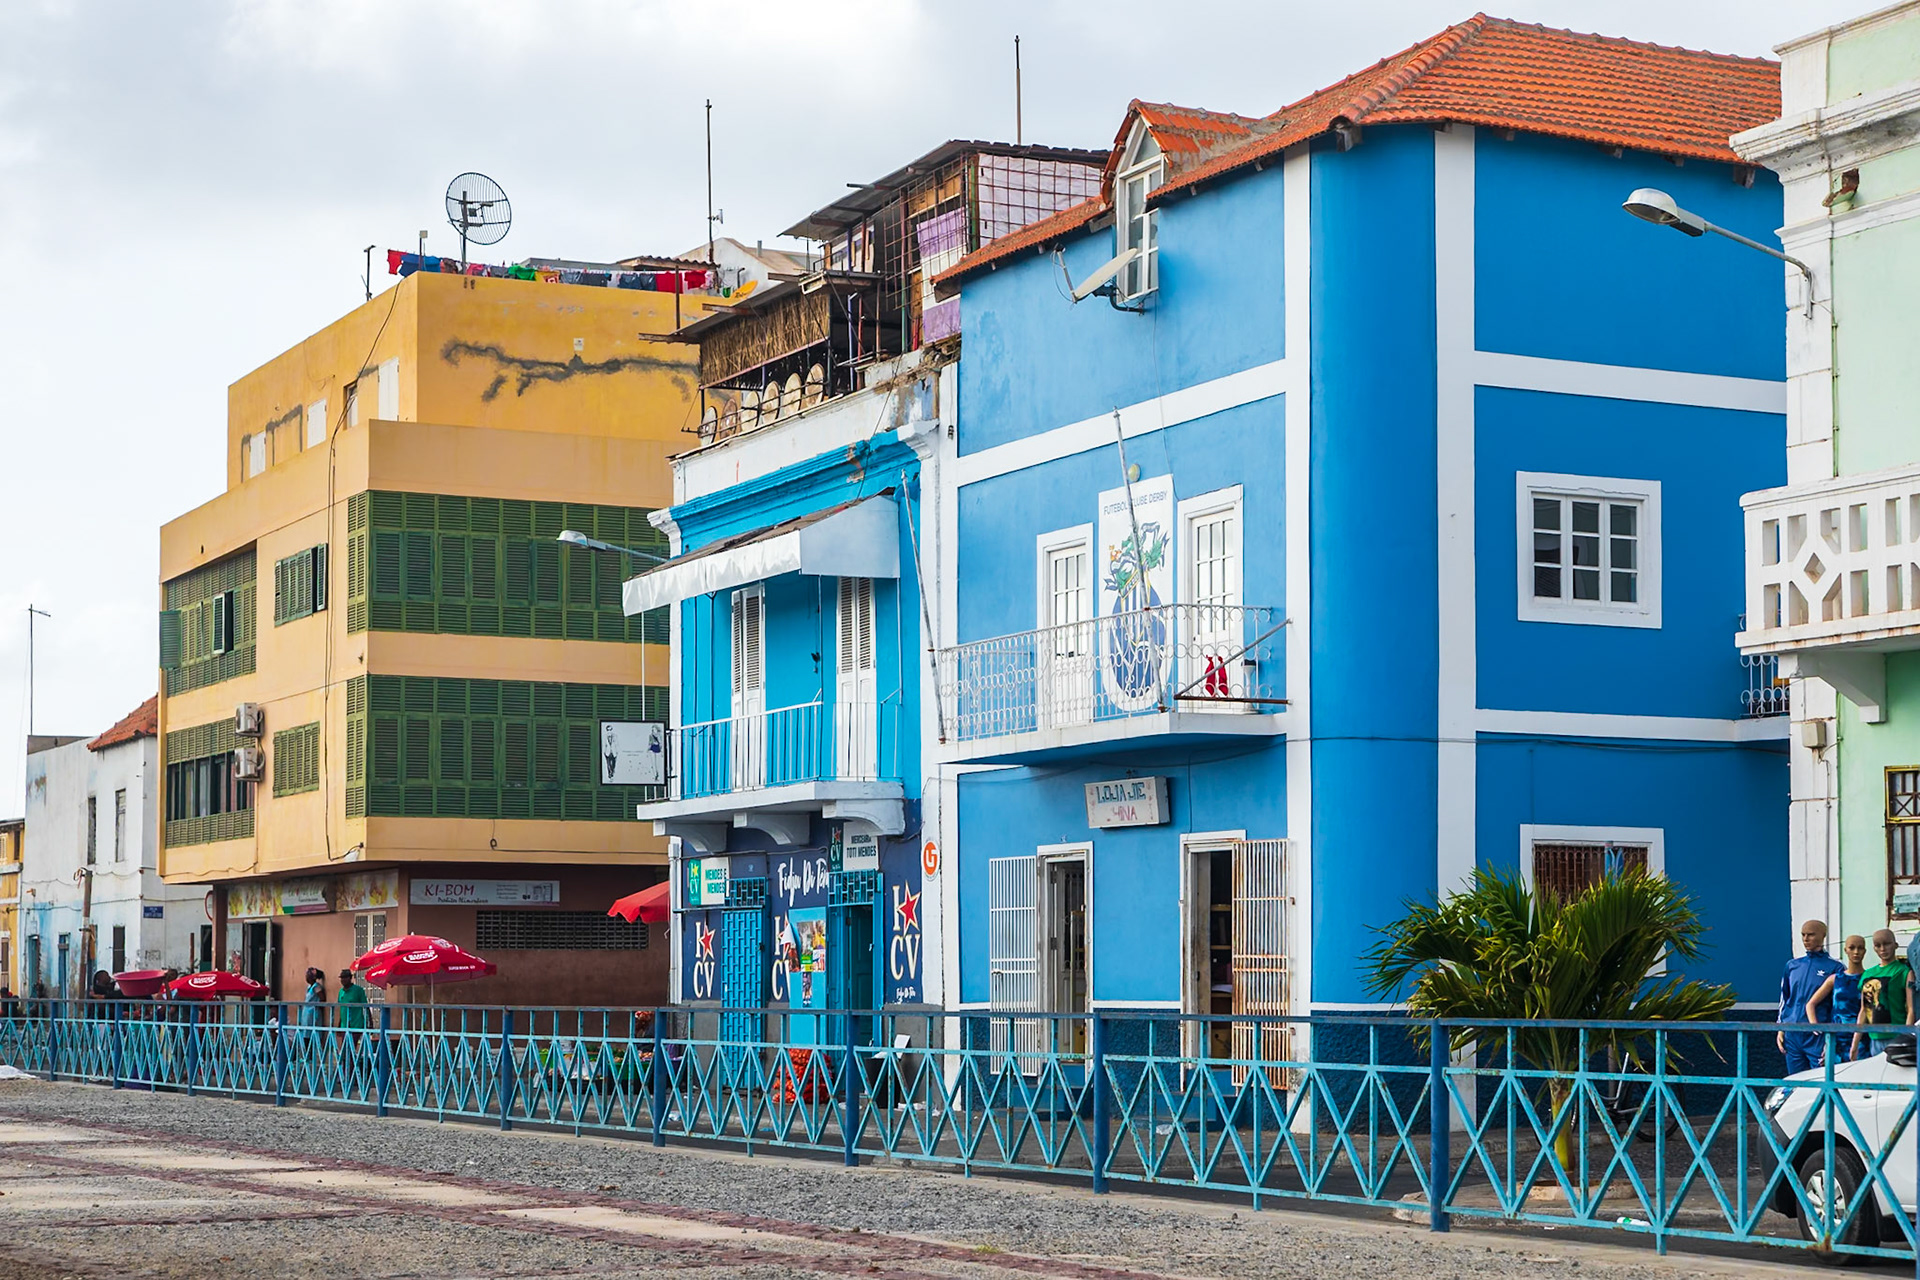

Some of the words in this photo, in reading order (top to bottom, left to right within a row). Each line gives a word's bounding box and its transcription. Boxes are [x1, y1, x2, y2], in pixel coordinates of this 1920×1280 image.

[1103, 501, 1128, 516] FUTEBOL
[1149, 490, 1168, 503] DERBY
[830, 844, 841, 862] CV
[857, 845, 876, 858] MENDES
[705, 868, 723, 880] MENDES
[424, 884, 475, 897] KI-BOM
[707, 882, 726, 894] MENDES
[890, 934, 921, 981] CV
[693, 961, 716, 999] CV
